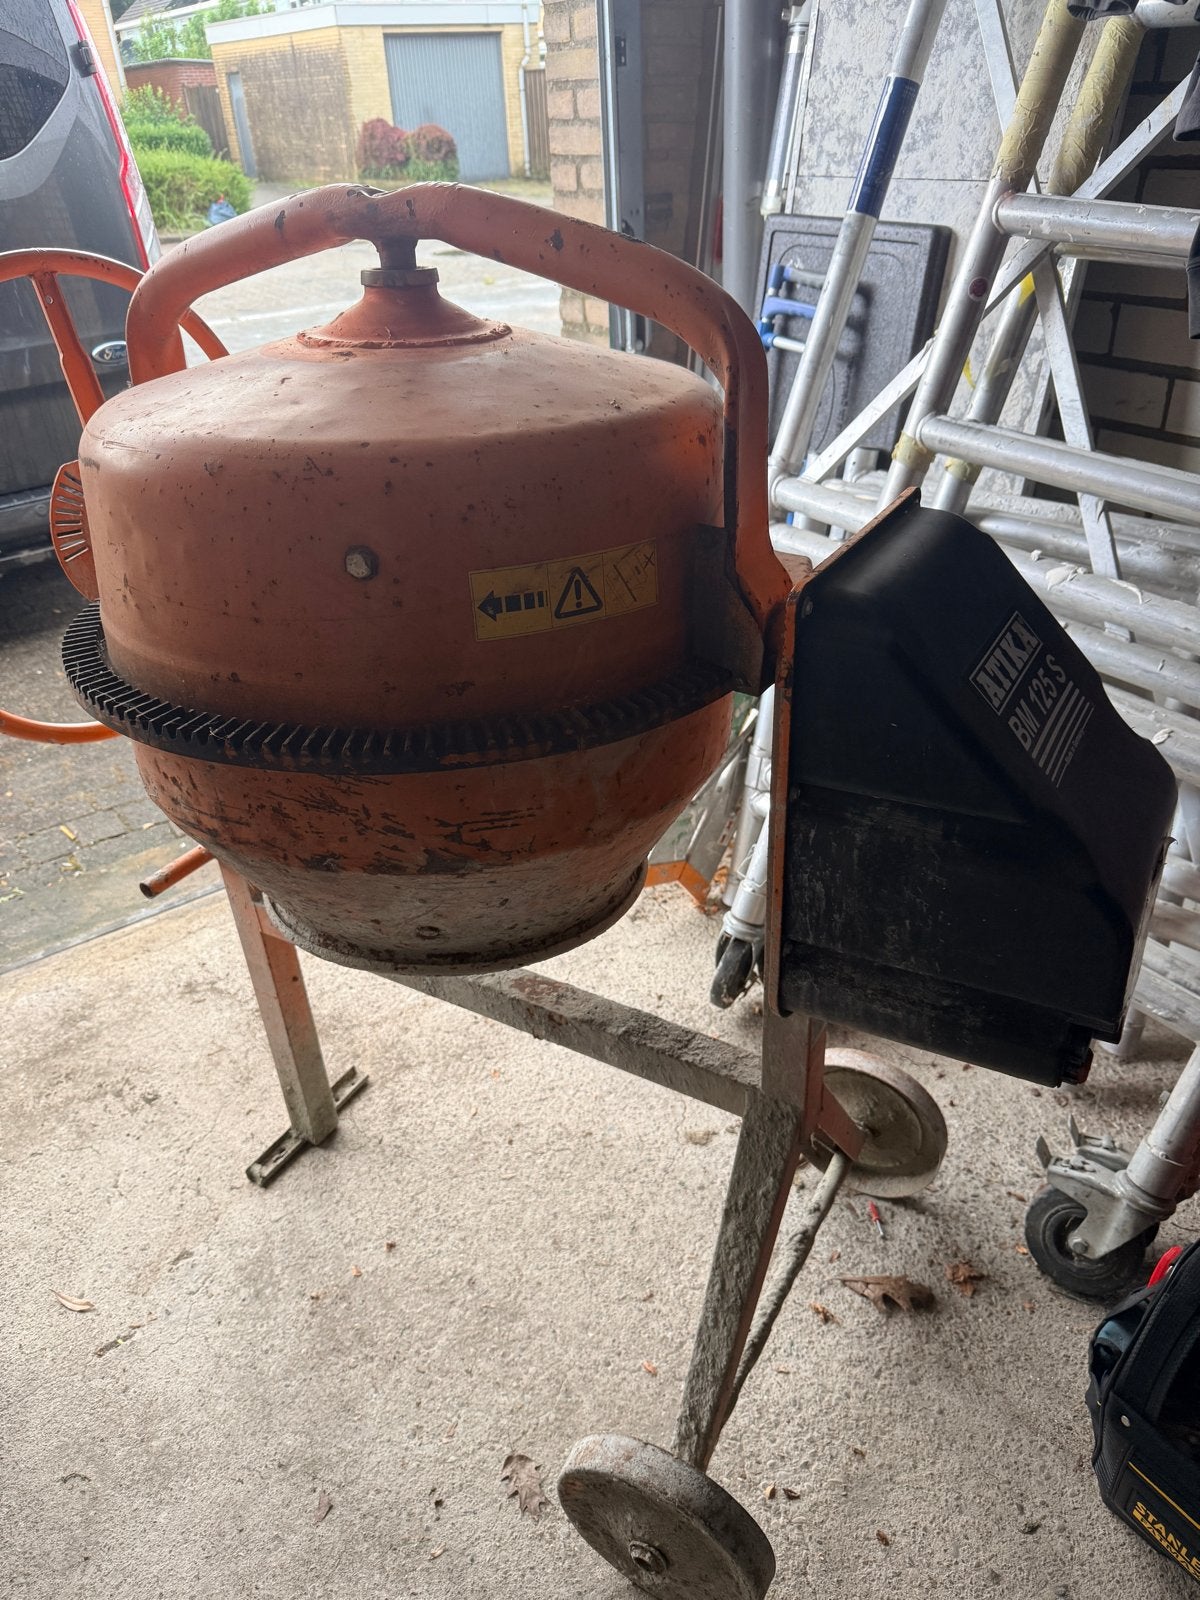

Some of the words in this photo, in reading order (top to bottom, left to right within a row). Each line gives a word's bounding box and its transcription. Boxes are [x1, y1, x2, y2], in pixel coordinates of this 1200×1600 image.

[976, 620, 1039, 709] ATIKA
[1007, 698, 1040, 752] BM
[1028, 667, 1057, 715] 125
[1046, 654, 1066, 683] S
[1135, 1501, 1200, 1573] STANLE
